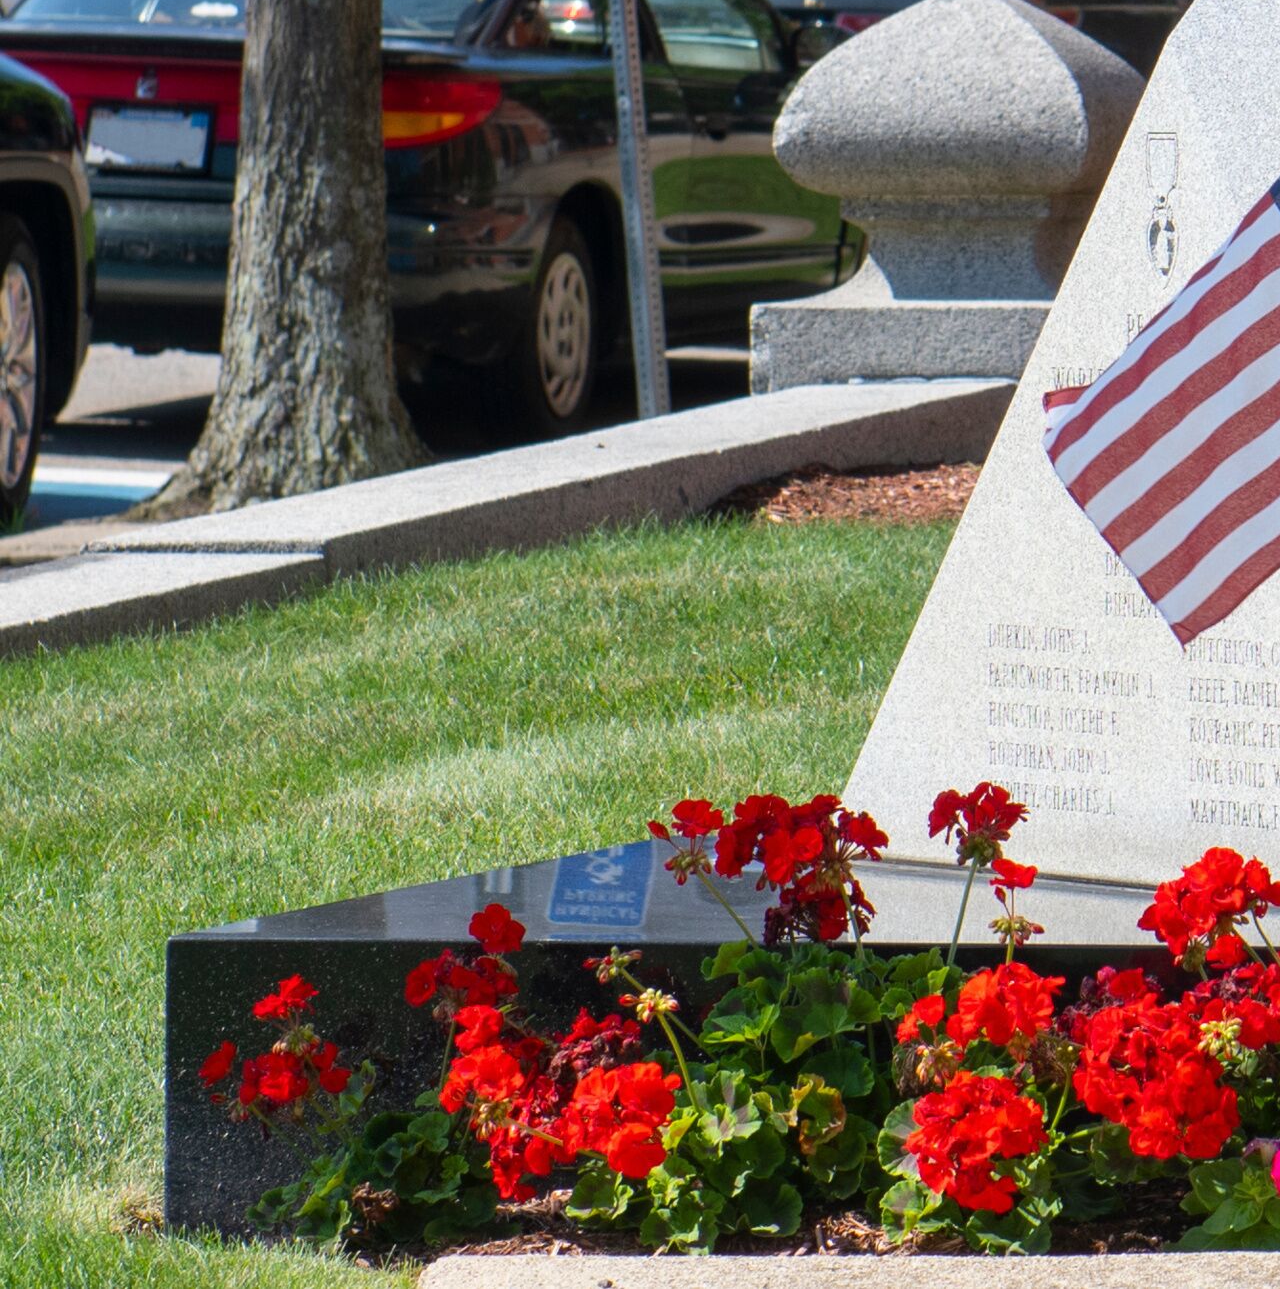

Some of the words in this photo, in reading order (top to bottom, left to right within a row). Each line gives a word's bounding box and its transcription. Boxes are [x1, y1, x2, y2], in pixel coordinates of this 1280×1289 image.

[1041, 626, 1075, 653] JOHN
[1078, 668, 1140, 697] FRANKLIN
[1233, 680, 1280, 709] DANIEL
[1058, 707, 1105, 736] JOSEPH
[1061, 747, 1095, 774] JOHN
[1228, 759, 1266, 789] LOUIS
[1044, 784, 1101, 815] CHARLES
